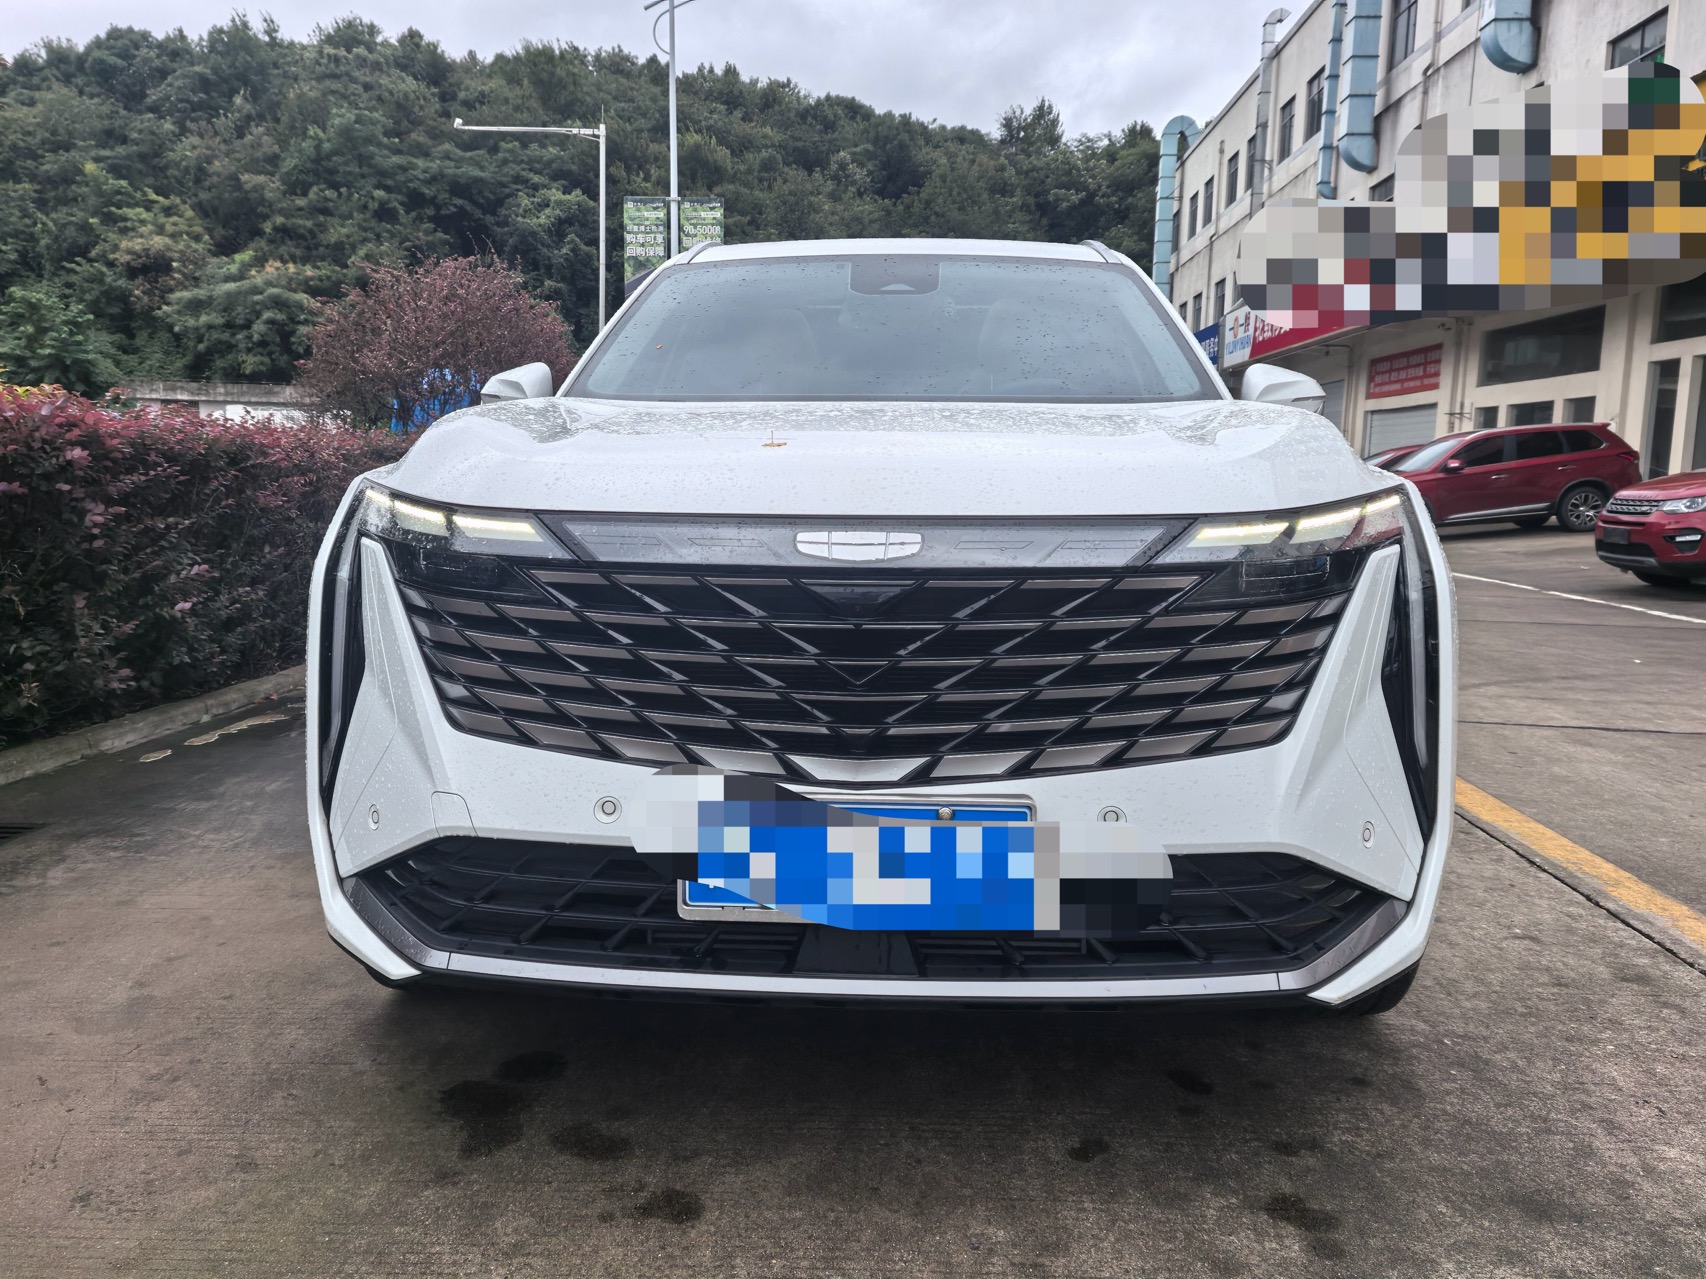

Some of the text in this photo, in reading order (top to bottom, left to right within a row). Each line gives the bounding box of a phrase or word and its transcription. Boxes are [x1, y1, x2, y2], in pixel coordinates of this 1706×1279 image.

[626, 234, 665, 244] 购车可享
[626, 246, 665, 257] 回购保障
